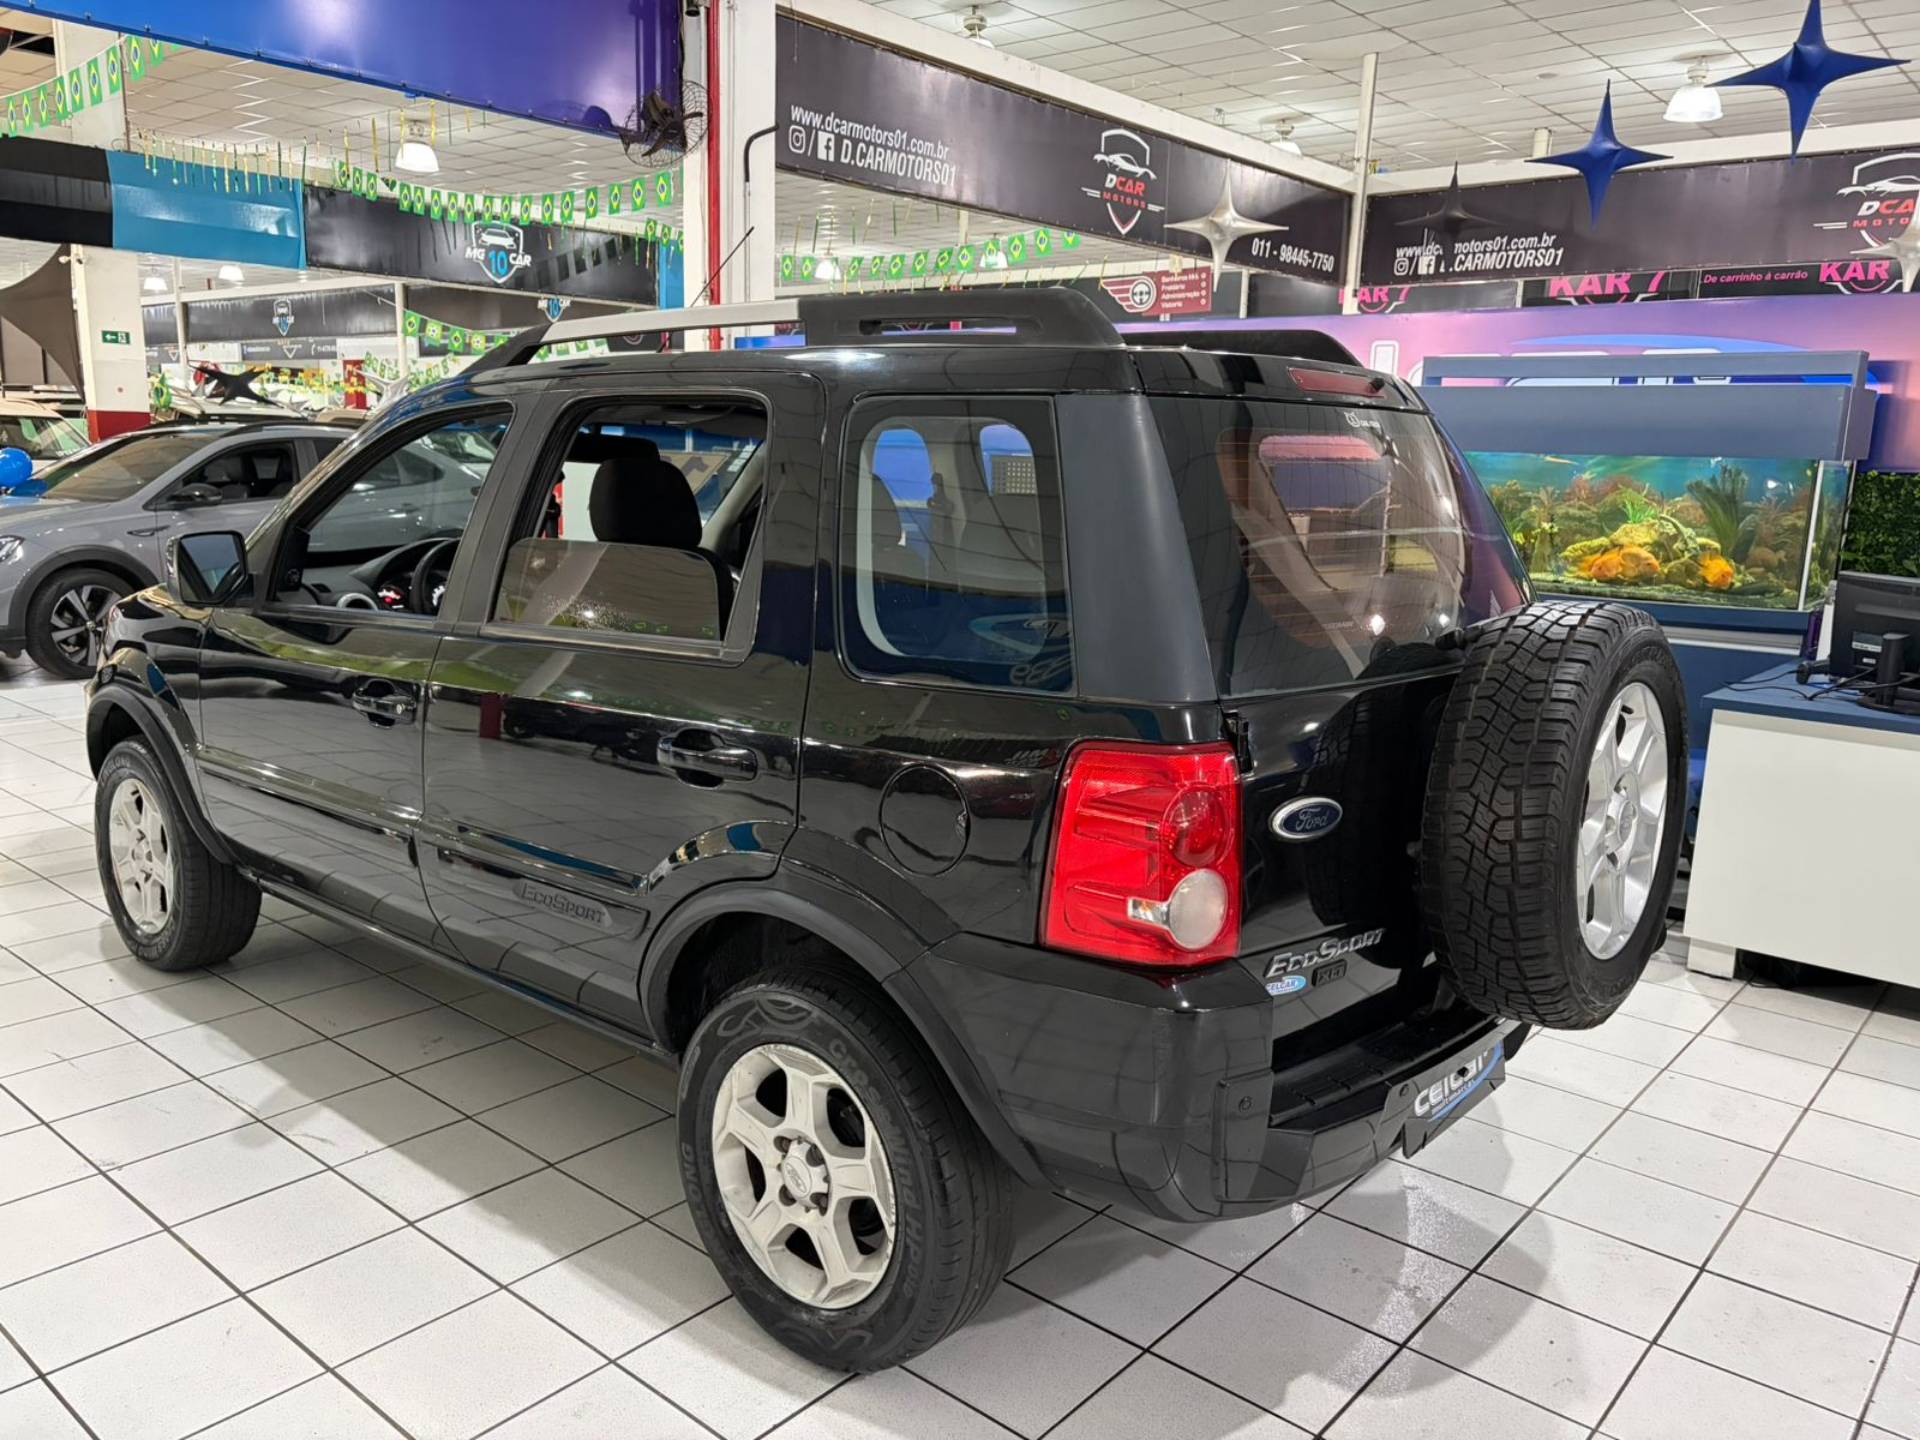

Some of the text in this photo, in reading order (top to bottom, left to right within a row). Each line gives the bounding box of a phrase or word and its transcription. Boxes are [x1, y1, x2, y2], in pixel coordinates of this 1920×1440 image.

[791, 104, 951, 160] www.dcarmotors01.com.br
[840, 138, 957, 187] D.CARMOTORS01
[1104, 174, 1146, 197] DCAR
[1103, 191, 1147, 209] MOTORS
[1857, 198, 1915, 216] DCA
[1853, 217, 1911, 228] MOTO
[1251, 238, 1271, 259] 011
[1279, 243, 1335, 273] 98445-7750
[1396, 232, 1557, 258] www.dcmotors01.com.br
[465, 246, 533, 277] MG 10 CAR
[1819, 260, 1891, 283] KAR
[1550, 271, 1632, 298] KAR
[1703, 273, 1718, 284] De
[1720, 272, 1763, 283] carrinho
[1295, 807, 1330, 832] Ford
